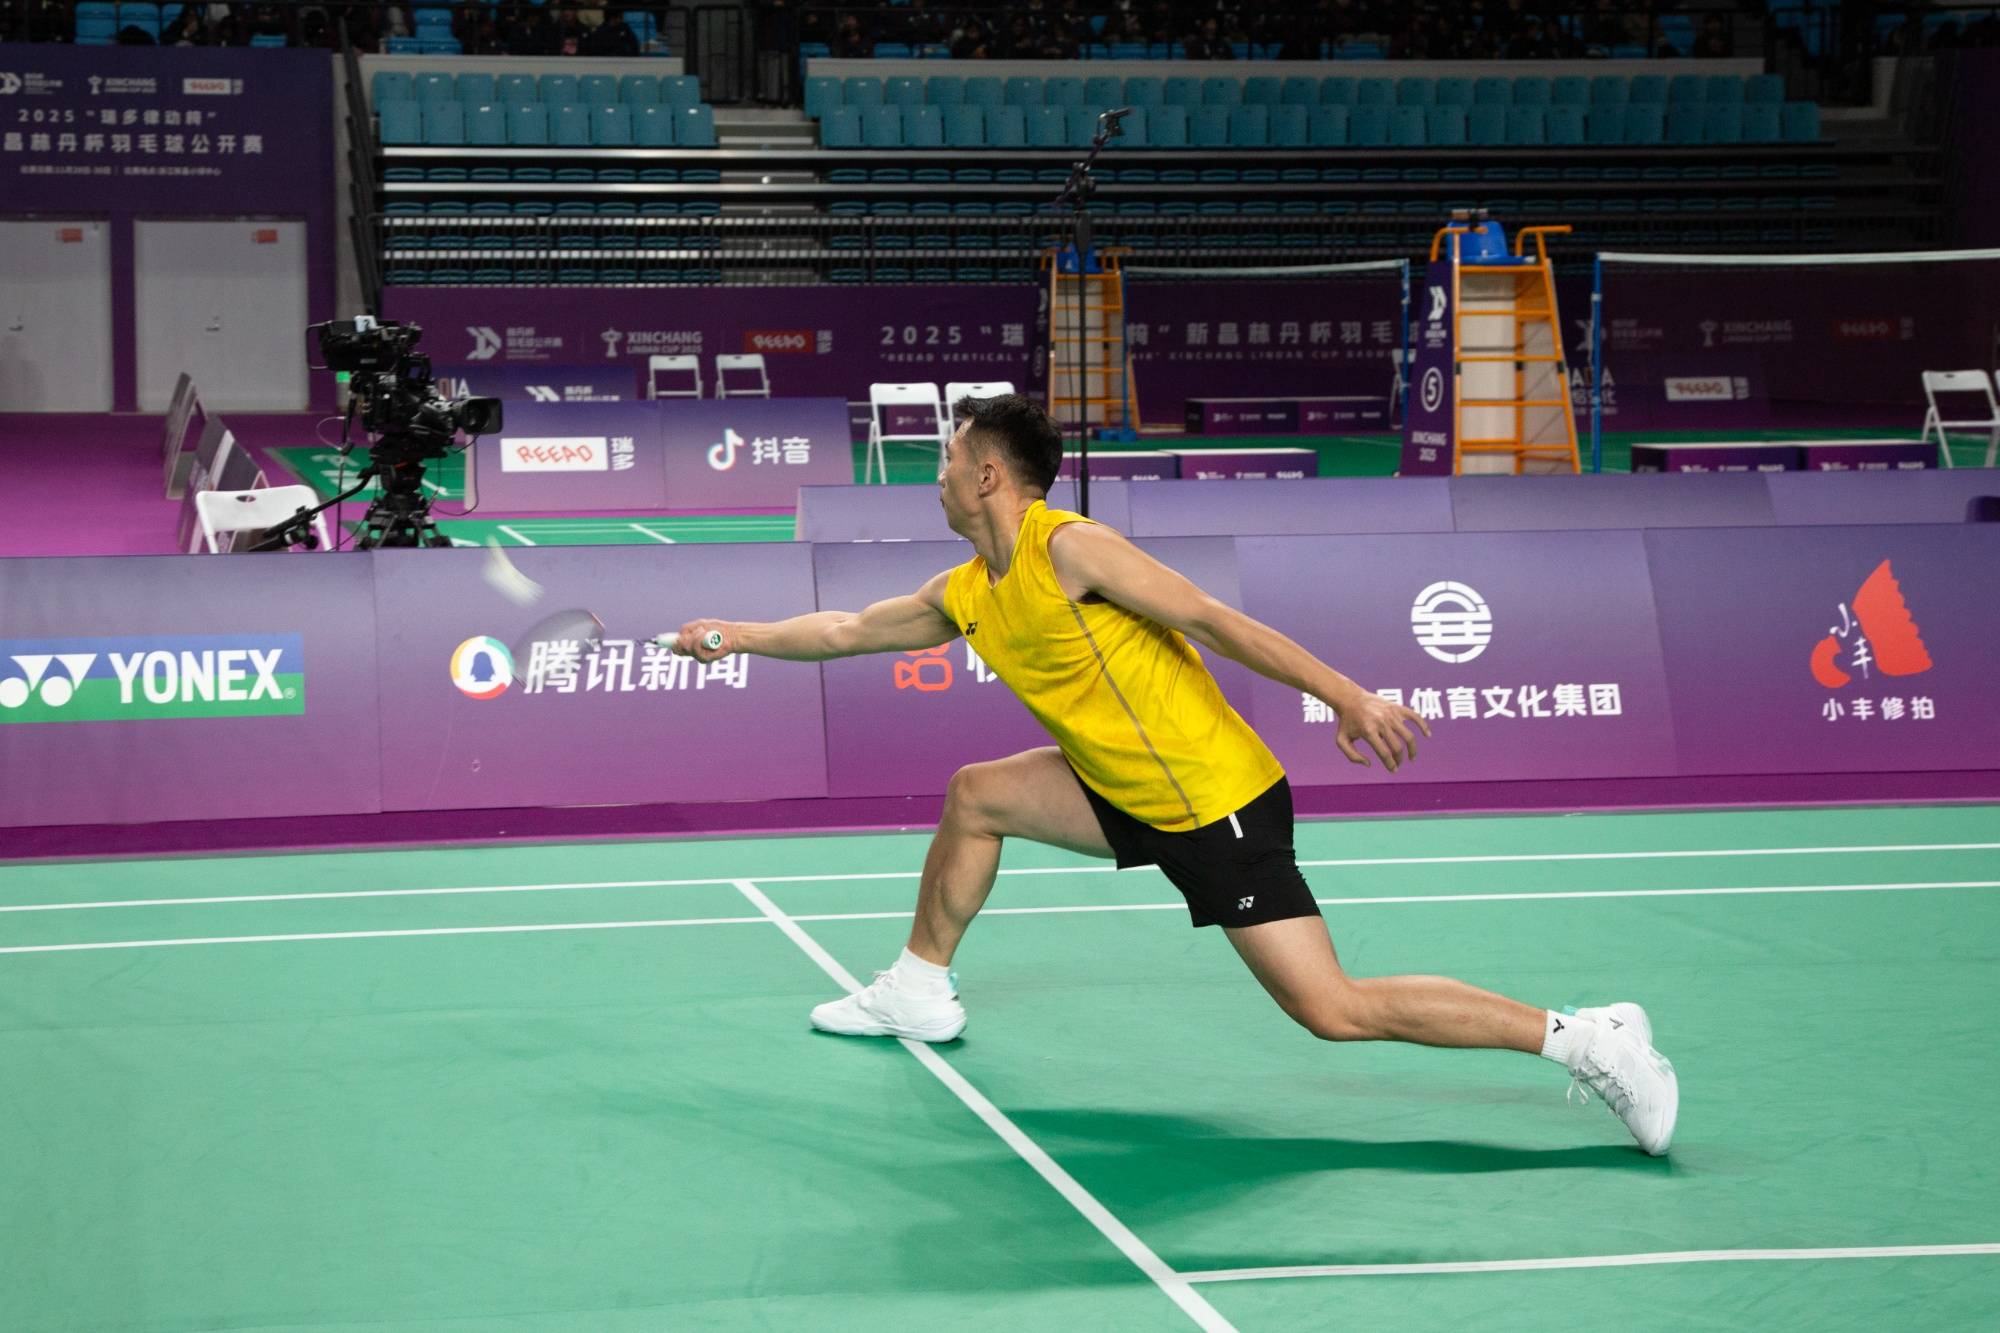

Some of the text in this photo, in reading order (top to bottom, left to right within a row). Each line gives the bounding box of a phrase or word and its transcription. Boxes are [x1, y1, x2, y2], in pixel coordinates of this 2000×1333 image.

[18, 109, 75, 122] 2025
[627, 331, 703, 344] XINCHANG
[880, 325, 963, 345] 2025
[1426, 375, 1438, 401] 5
[516, 443, 594, 463] REEAD
[610, 436, 636, 471] 瑞多
[752, 436, 812, 465] 抖音
[107, 649, 284, 704] YONEX
[523, 638, 750, 694] 腾讯新闻
[1301, 683, 1622, 723] 新体育文化集团
[1822, 696, 1936, 722] 小丰修拍
